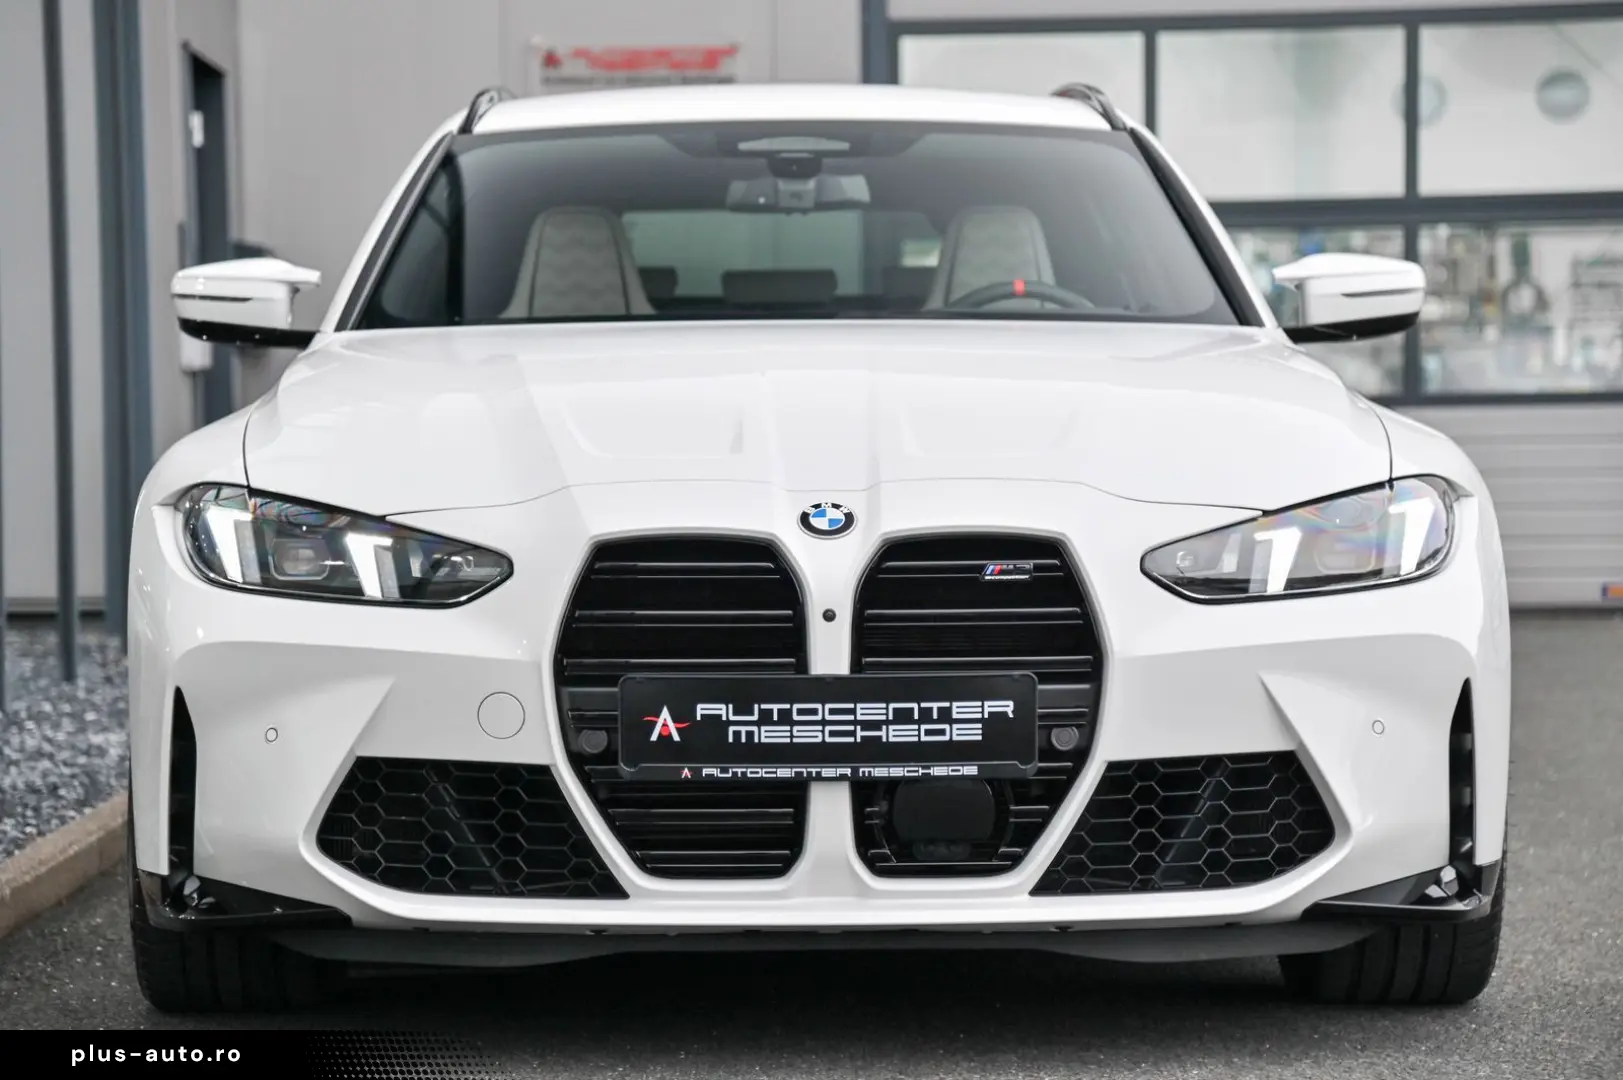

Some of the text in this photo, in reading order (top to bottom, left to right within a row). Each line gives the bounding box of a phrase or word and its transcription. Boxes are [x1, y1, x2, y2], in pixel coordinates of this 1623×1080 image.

[696, 700, 1015, 721] AUTOCENTER
[728, 723, 983, 743] MESCHEDE
[702, 767, 852, 778] AUTOCENTER
[859, 766, 978, 777] MESCHEDE
